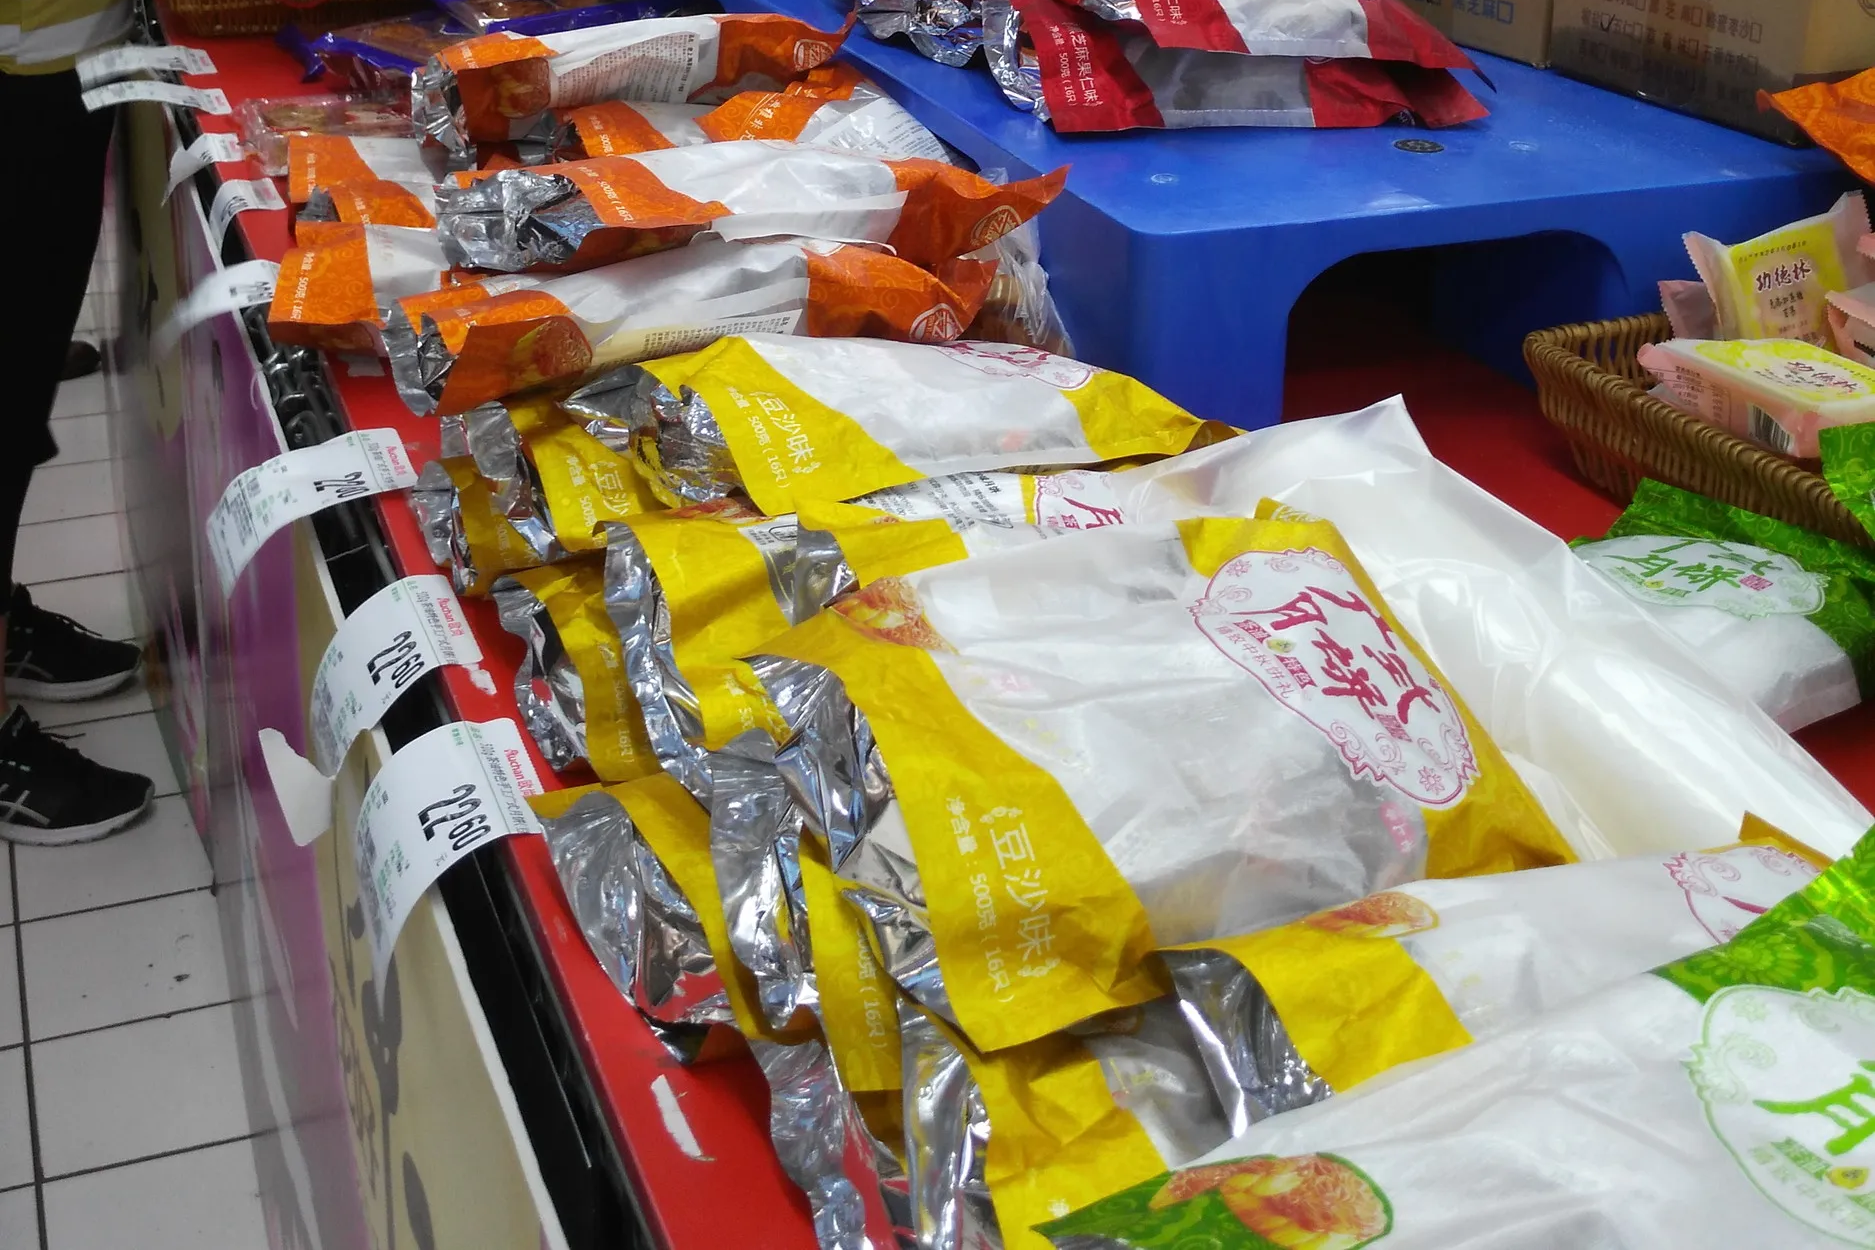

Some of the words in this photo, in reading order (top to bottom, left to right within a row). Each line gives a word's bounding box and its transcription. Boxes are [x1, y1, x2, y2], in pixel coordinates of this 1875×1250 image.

[1755, 258, 1811, 291] 功德林
[756, 397, 815, 464] 豆沙味
[594, 470, 631, 515] 豆沙
[1229, 591, 1388, 720] 月饼
[1283, 656, 1313, 688] 特色
[504, 748, 524, 781] Auchan
[990, 823, 1056, 961] 豆沙味
